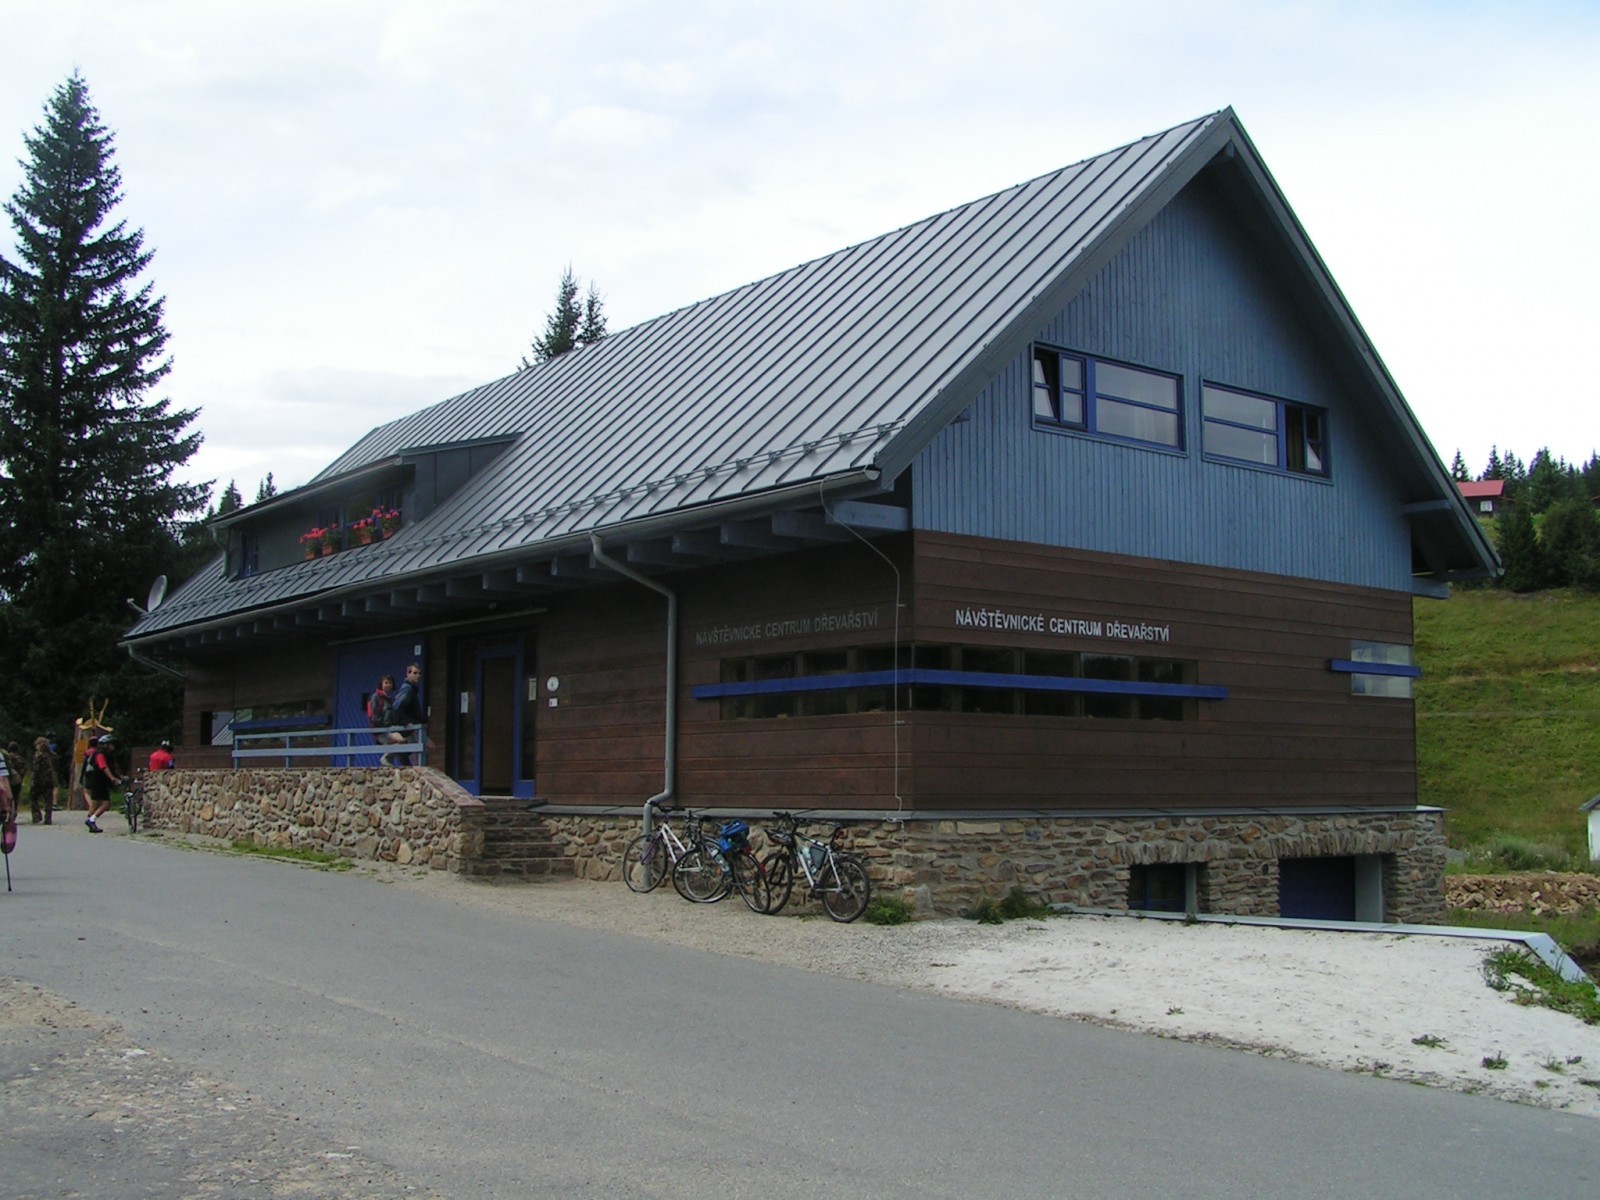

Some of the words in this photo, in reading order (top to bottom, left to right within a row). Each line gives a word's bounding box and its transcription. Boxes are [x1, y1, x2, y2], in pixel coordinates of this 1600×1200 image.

[696, 621, 761, 645] NÁVŠTĚVNICKÉ
[765, 618, 810, 637] CENTRUM
[814, 607, 878, 632] DŘEVAŘSTVÍ
[955, 607, 1044, 631] NÁVŠTĚVNICKÉ
[1049, 617, 1102, 636] CENTRUM
[1106, 620, 1170, 642] DŘEVAŘSTVÍ
